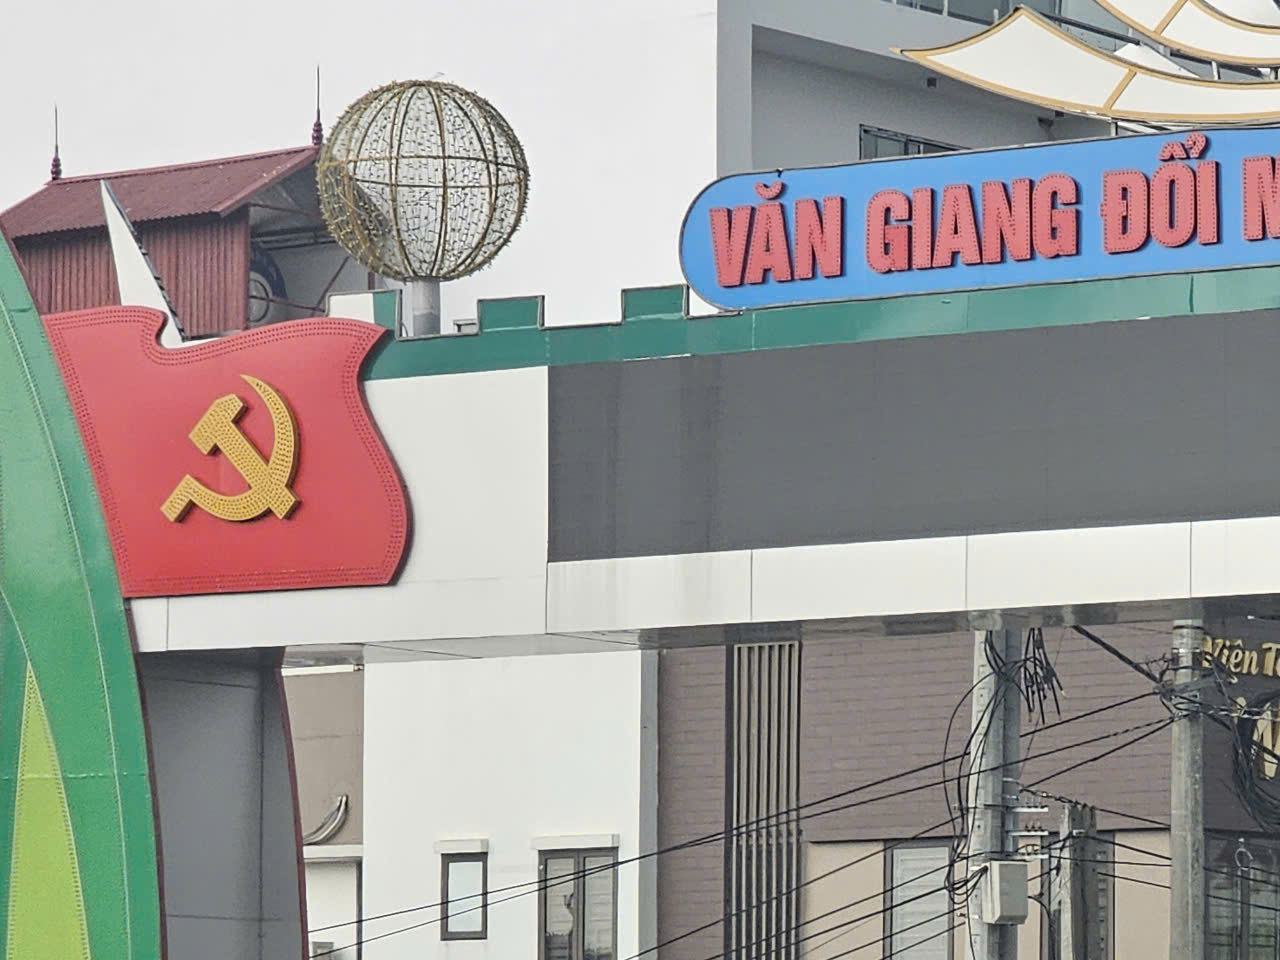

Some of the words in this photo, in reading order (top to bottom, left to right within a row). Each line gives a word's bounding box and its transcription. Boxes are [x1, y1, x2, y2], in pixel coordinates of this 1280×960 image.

[708, 181, 845, 288] VĂN
[866, 173, 1078, 274] GIANG
[1100, 132, 1220, 255] ĐỔI
